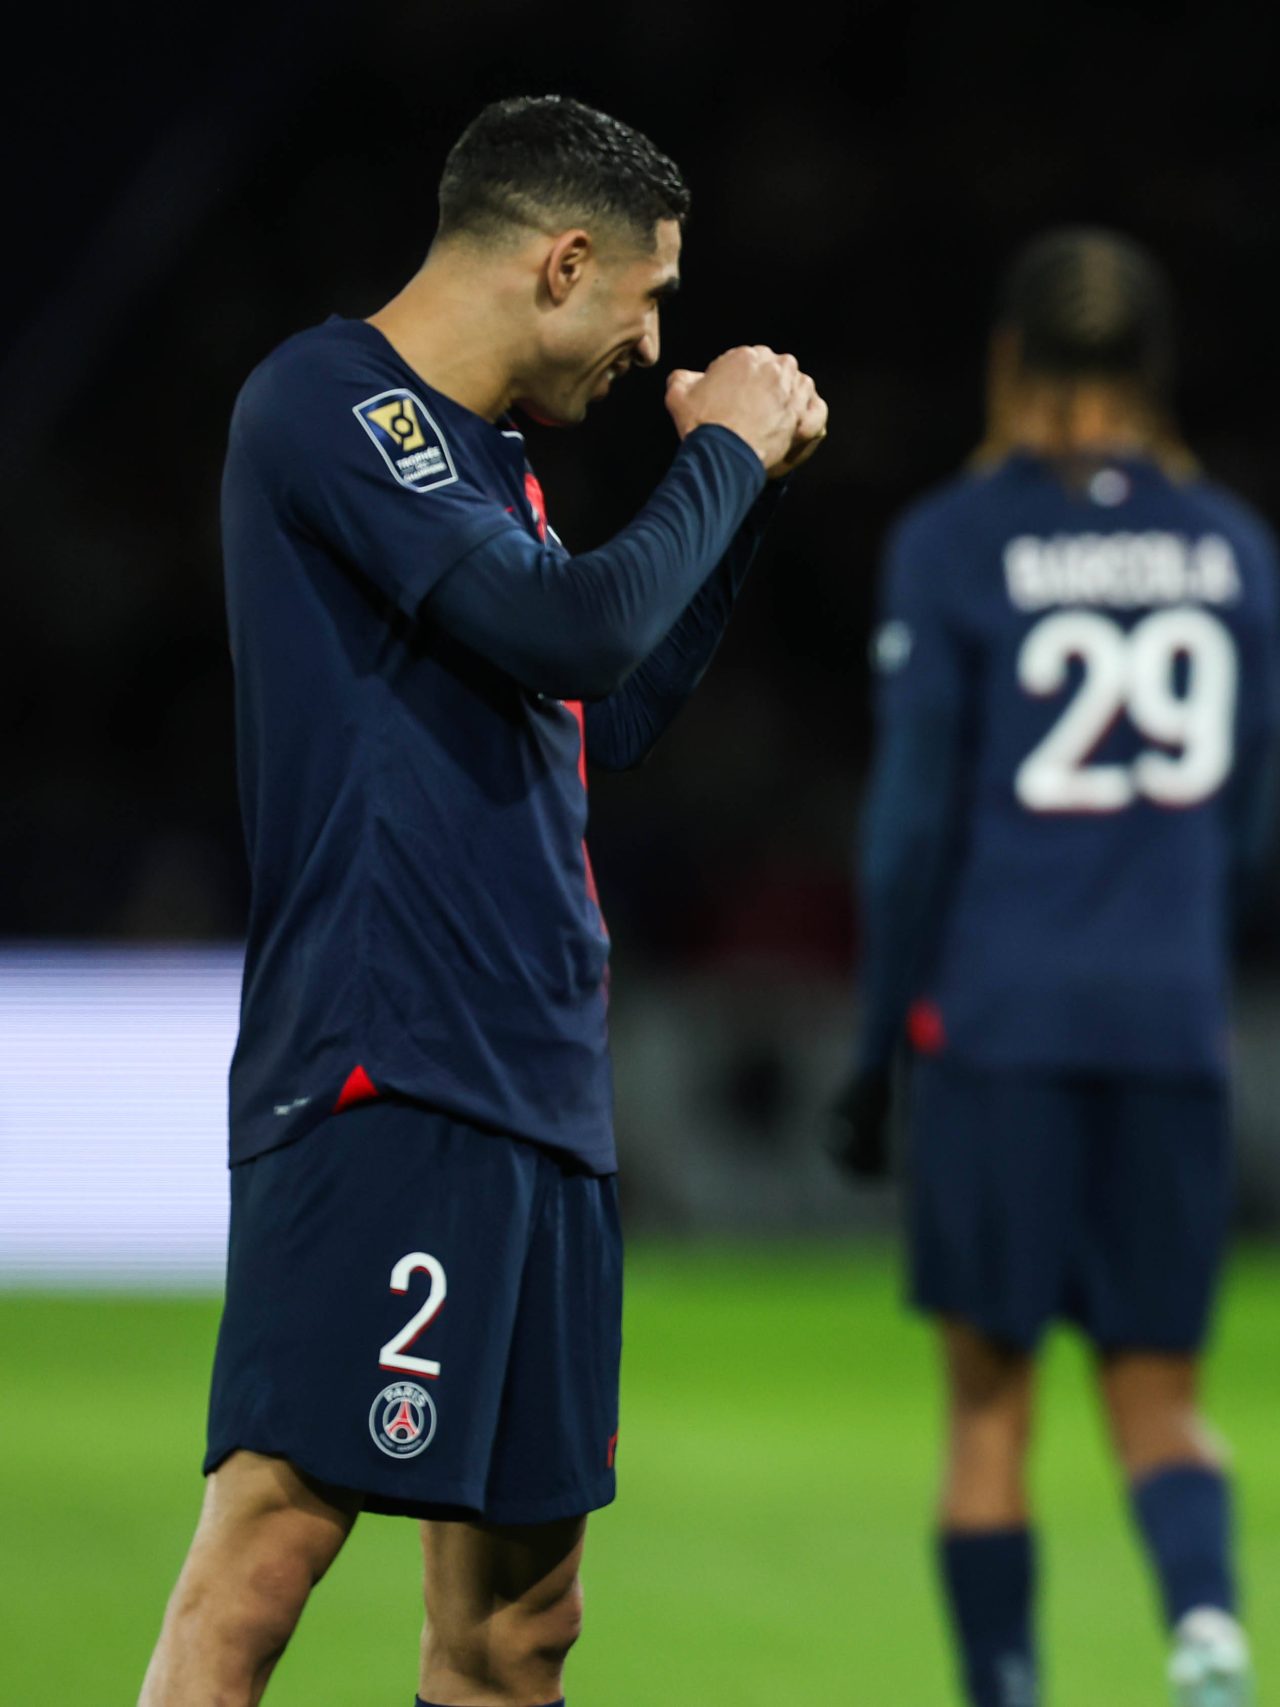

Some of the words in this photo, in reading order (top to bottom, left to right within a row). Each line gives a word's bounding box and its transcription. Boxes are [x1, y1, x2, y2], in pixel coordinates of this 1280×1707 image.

[1015, 605, 1238, 814] 29
[379, 1252, 447, 1380] 2
[383, 1386, 427, 1408] PARIS
